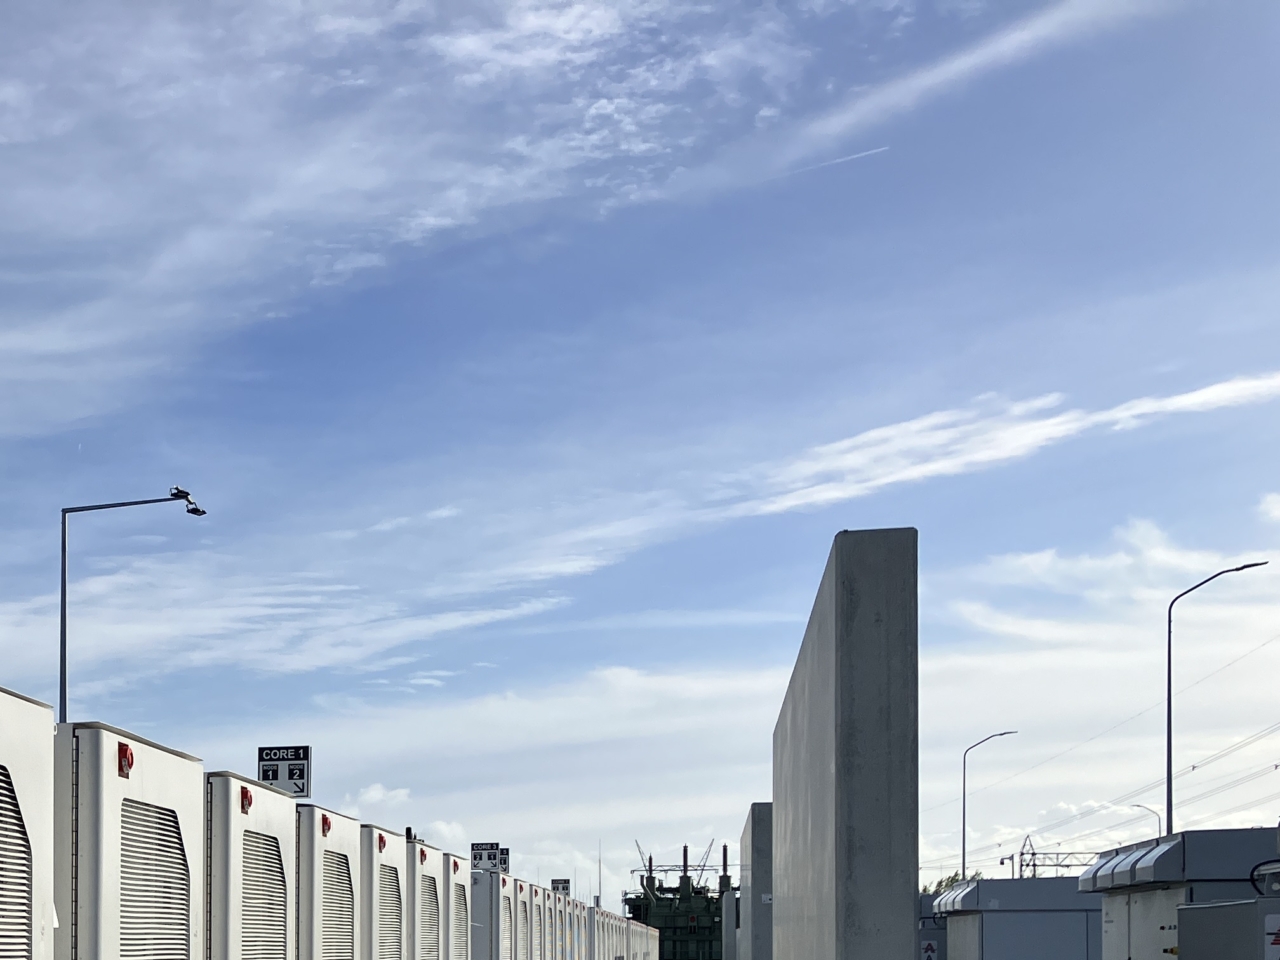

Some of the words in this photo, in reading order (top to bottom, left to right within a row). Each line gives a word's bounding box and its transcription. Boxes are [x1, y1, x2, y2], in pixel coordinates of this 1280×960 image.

[263, 749, 295, 759] CORE
[298, 749, 304, 758] 1
[267, 771, 273, 780] 1
[293, 770, 300, 779] 2
